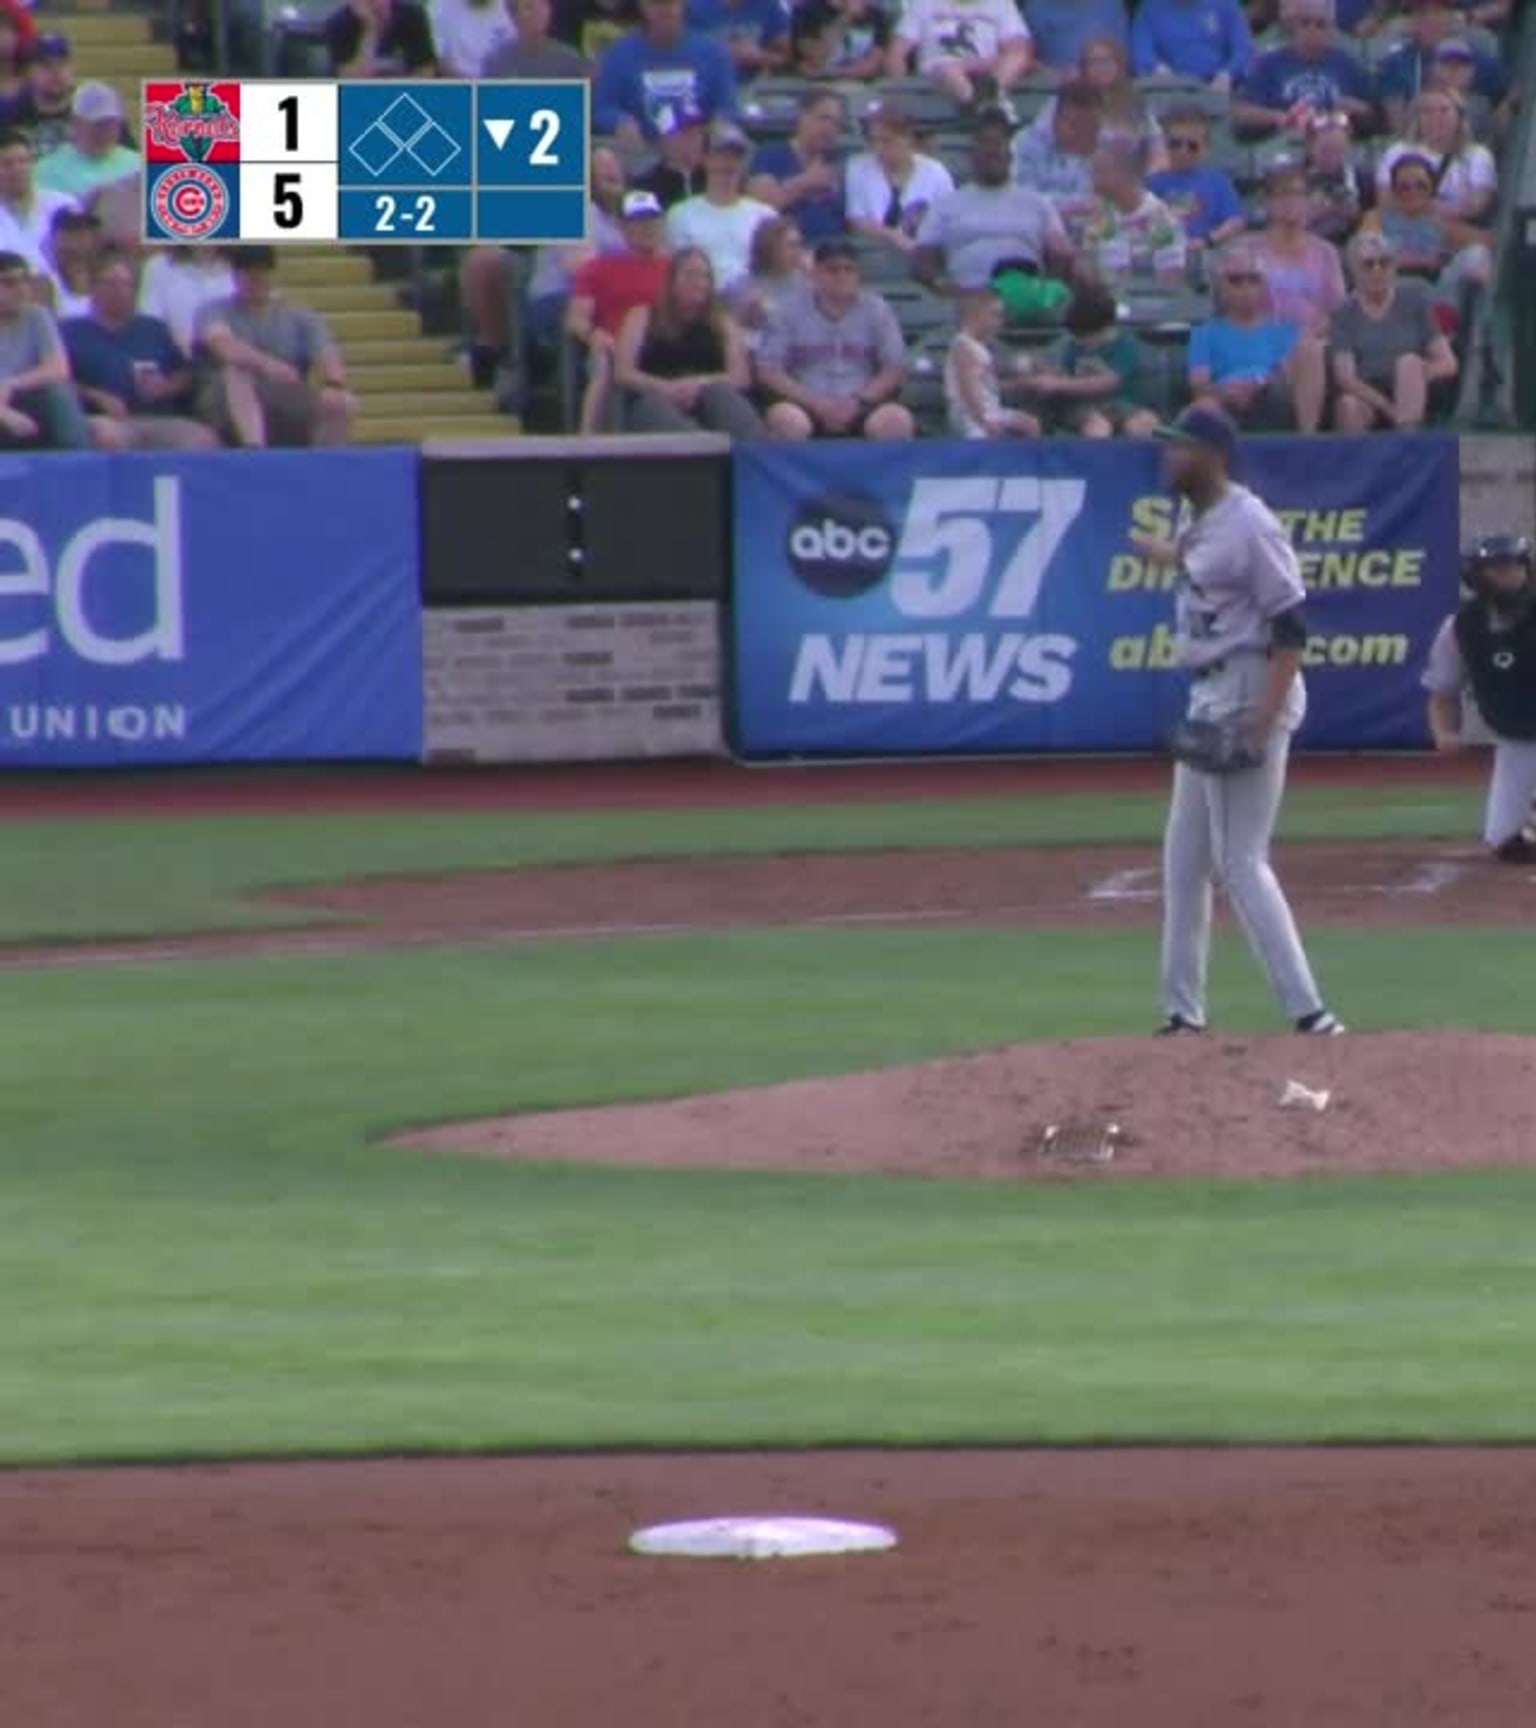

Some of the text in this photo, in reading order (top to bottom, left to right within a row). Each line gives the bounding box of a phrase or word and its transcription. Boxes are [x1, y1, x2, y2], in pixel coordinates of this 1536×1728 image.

[790, 519, 890, 560] abc
[891, 476, 1087, 619] 57
[787, 632, 1079, 703] NEWS
[9, 702, 186, 741] UNION
